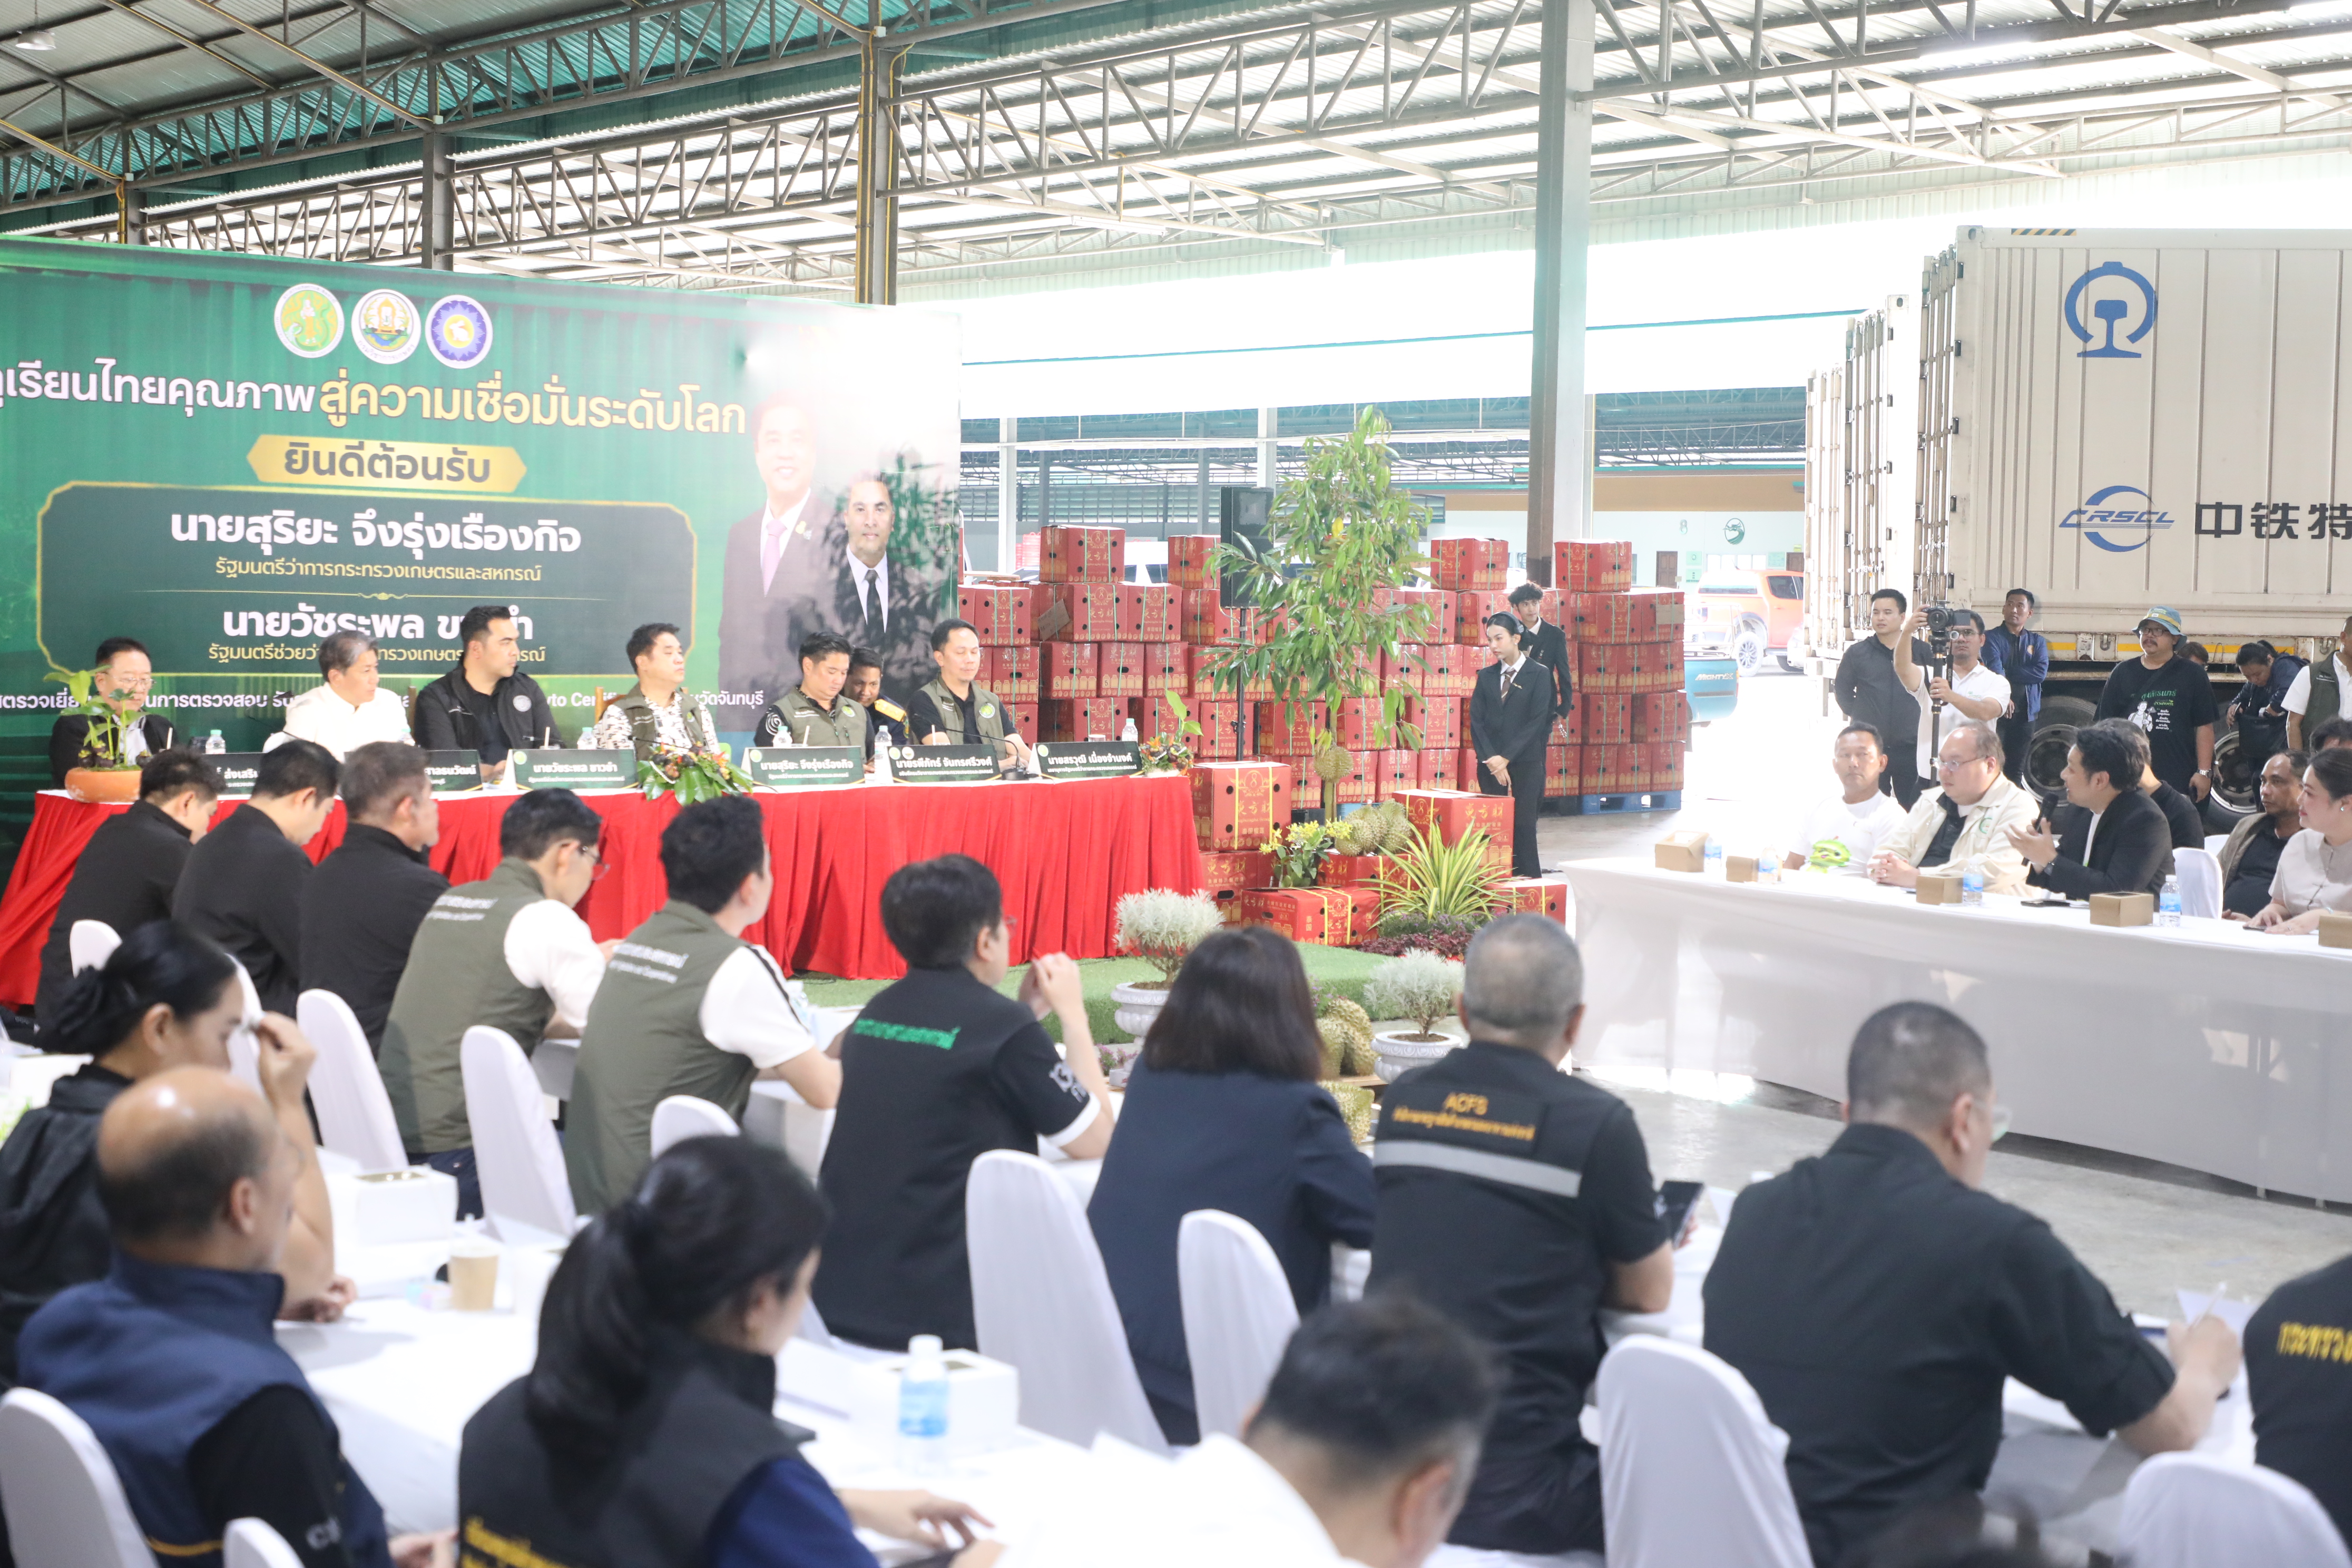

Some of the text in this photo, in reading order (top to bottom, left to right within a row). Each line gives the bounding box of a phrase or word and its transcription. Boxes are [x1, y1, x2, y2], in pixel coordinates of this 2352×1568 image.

[0, 358, 746, 435] ุเรียนไทยคุณภาพ สู่ความเชื่อมั่นระดับโลก
[285, 441, 491, 483] ยินดีต้อนรับ
[171, 508, 581, 560] นายสุริยะ จึงรุ่งเรืองกิจ
[2059, 509, 2175, 527] CRSCL
[215, 557, 542, 582] รัฐมนตรีว่าการกระทรวงเกษตรและสหกรณ์
[760, 760, 799, 772] นายสุริยะ
